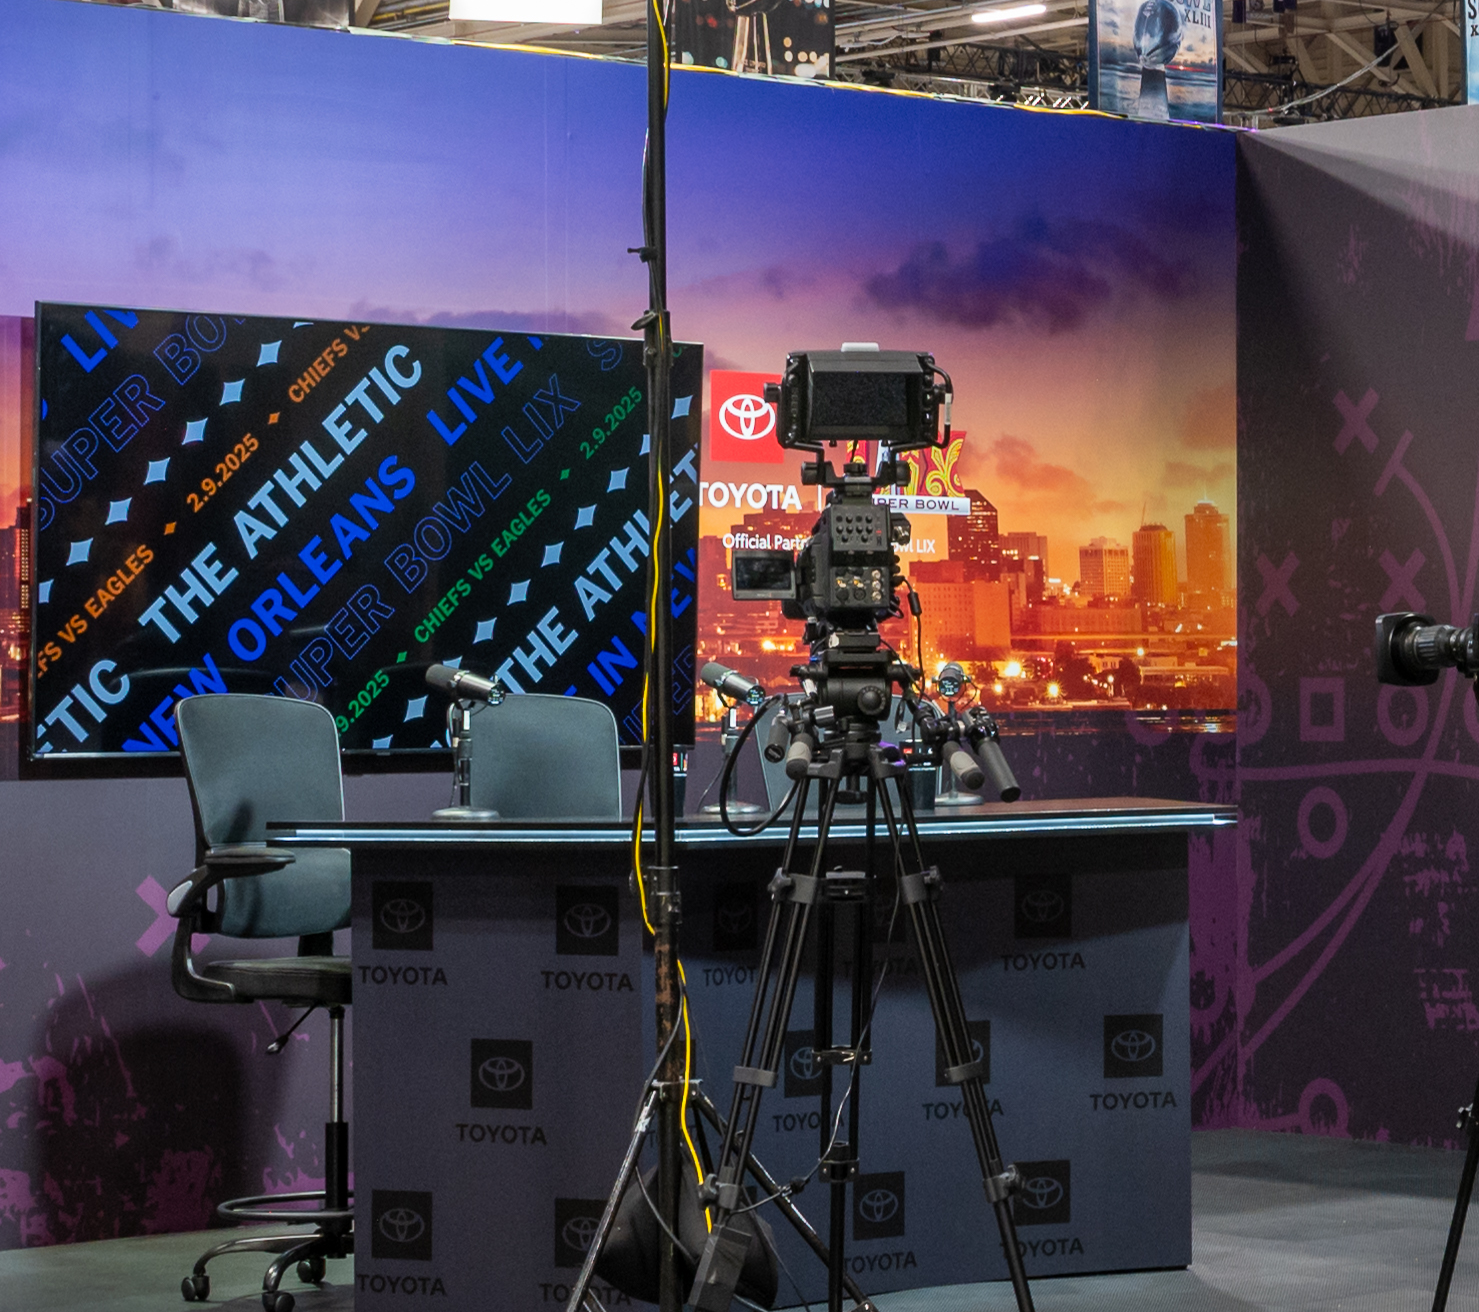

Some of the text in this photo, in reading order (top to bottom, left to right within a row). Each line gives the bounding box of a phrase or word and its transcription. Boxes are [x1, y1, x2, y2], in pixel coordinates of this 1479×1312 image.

[1184, 8, 1212, 29] XLIII
[57, 614, 88, 644] VS
[85, 544, 155, 620] EAGLES
[186, 432, 261, 514] 2.9.2025
[288, 338, 348, 405] CHIEFS
[138, 542, 239, 644] THE
[233, 344, 422, 560] ATHLETIC
[699, 481, 803, 510] TOYOTA
[413, 578, 472, 644] CHIEFS
[466, 553, 494, 582] VS
[490, 488, 552, 559] EAGLES
[579, 386, 643, 461] 2.9.2025
[915, 498, 960, 512] BOWL
[122, 337, 525, 752] NEW ORLEANS LIVE
[264, 373, 582, 701] UPER BOWL LIX
[722, 533, 771, 550] Official
[916, 538, 936, 553] LIX
[493, 605, 580, 696] THE
[1001, 952, 1085, 973] TOYOTA
[358, 966, 448, 988] TOYOTA
[541, 971, 634, 993] TOYOTA
[703, 966, 759, 987] TOYOT
[1089, 1091, 1177, 1112] TOYOTA
[455, 1124, 547, 1146] TOYOTA
[999, 1237, 1084, 1259] OYOTA
[356, 1274, 447, 1297] TOYOTA
